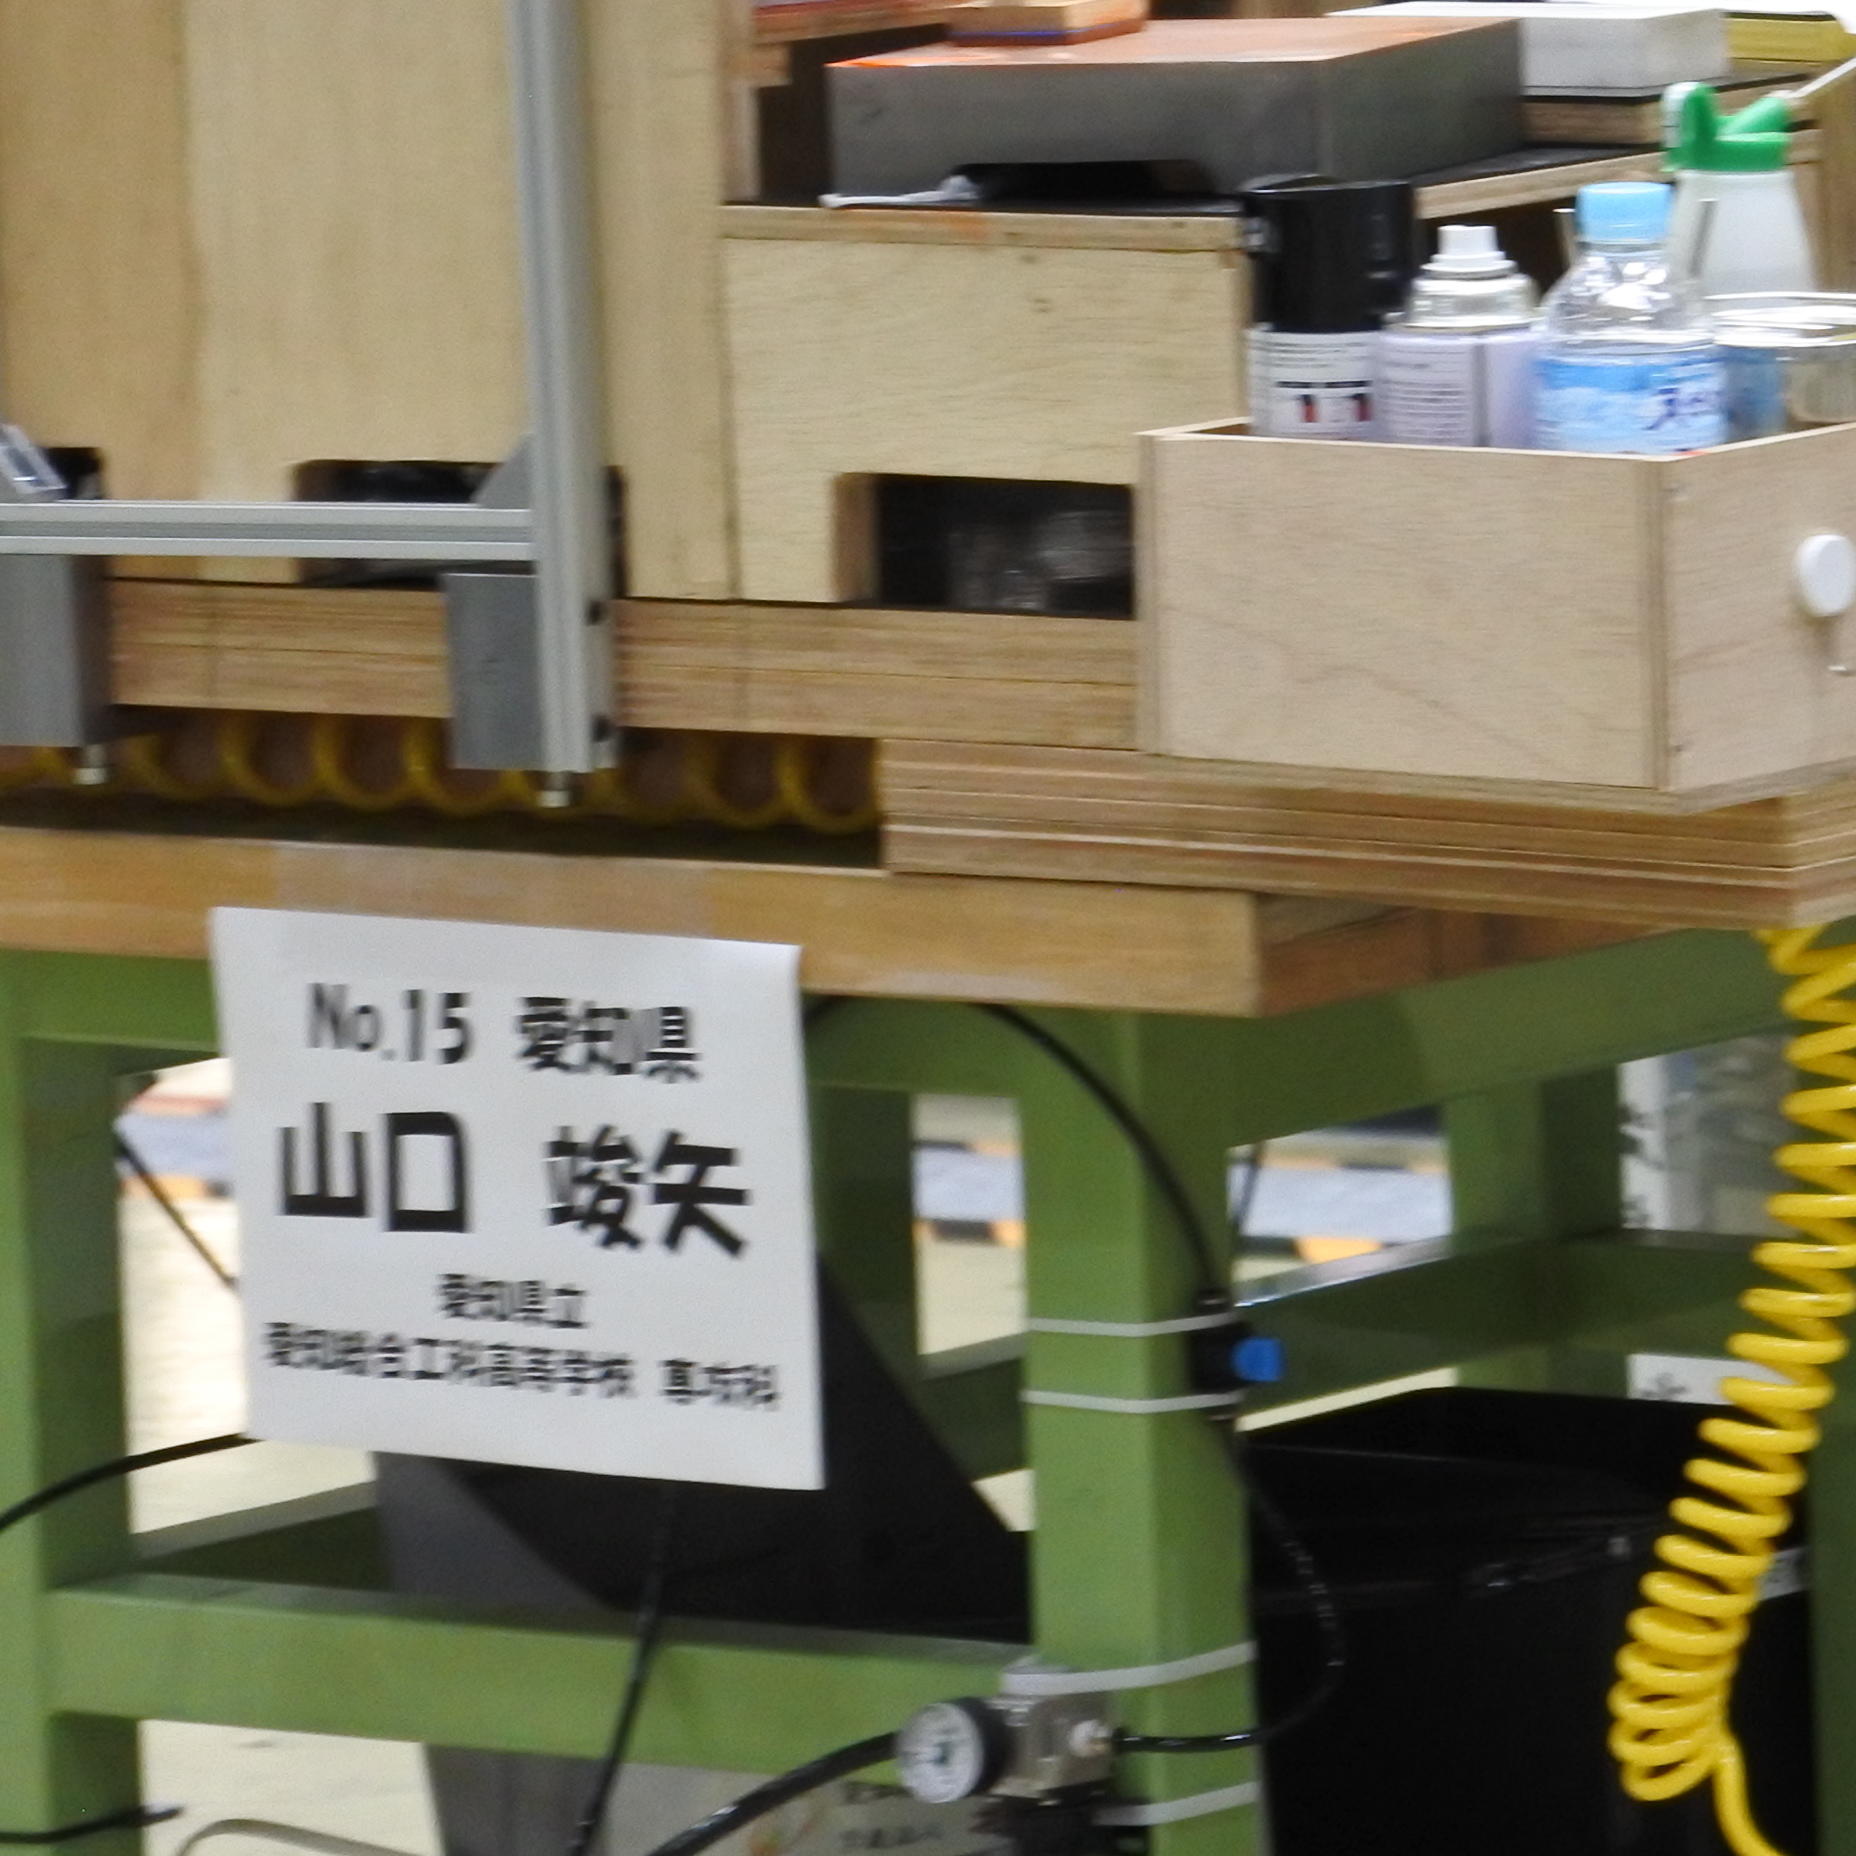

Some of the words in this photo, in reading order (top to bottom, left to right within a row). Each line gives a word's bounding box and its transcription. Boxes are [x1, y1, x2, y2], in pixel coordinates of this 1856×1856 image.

[308, 981, 472, 1064] No.15
[518, 996, 704, 1084] 愛知県
[275, 1102, 472, 1234] 山口
[543, 1125, 750, 1257] 竣矢
[437, 1272, 589, 1330] 愛知県立
